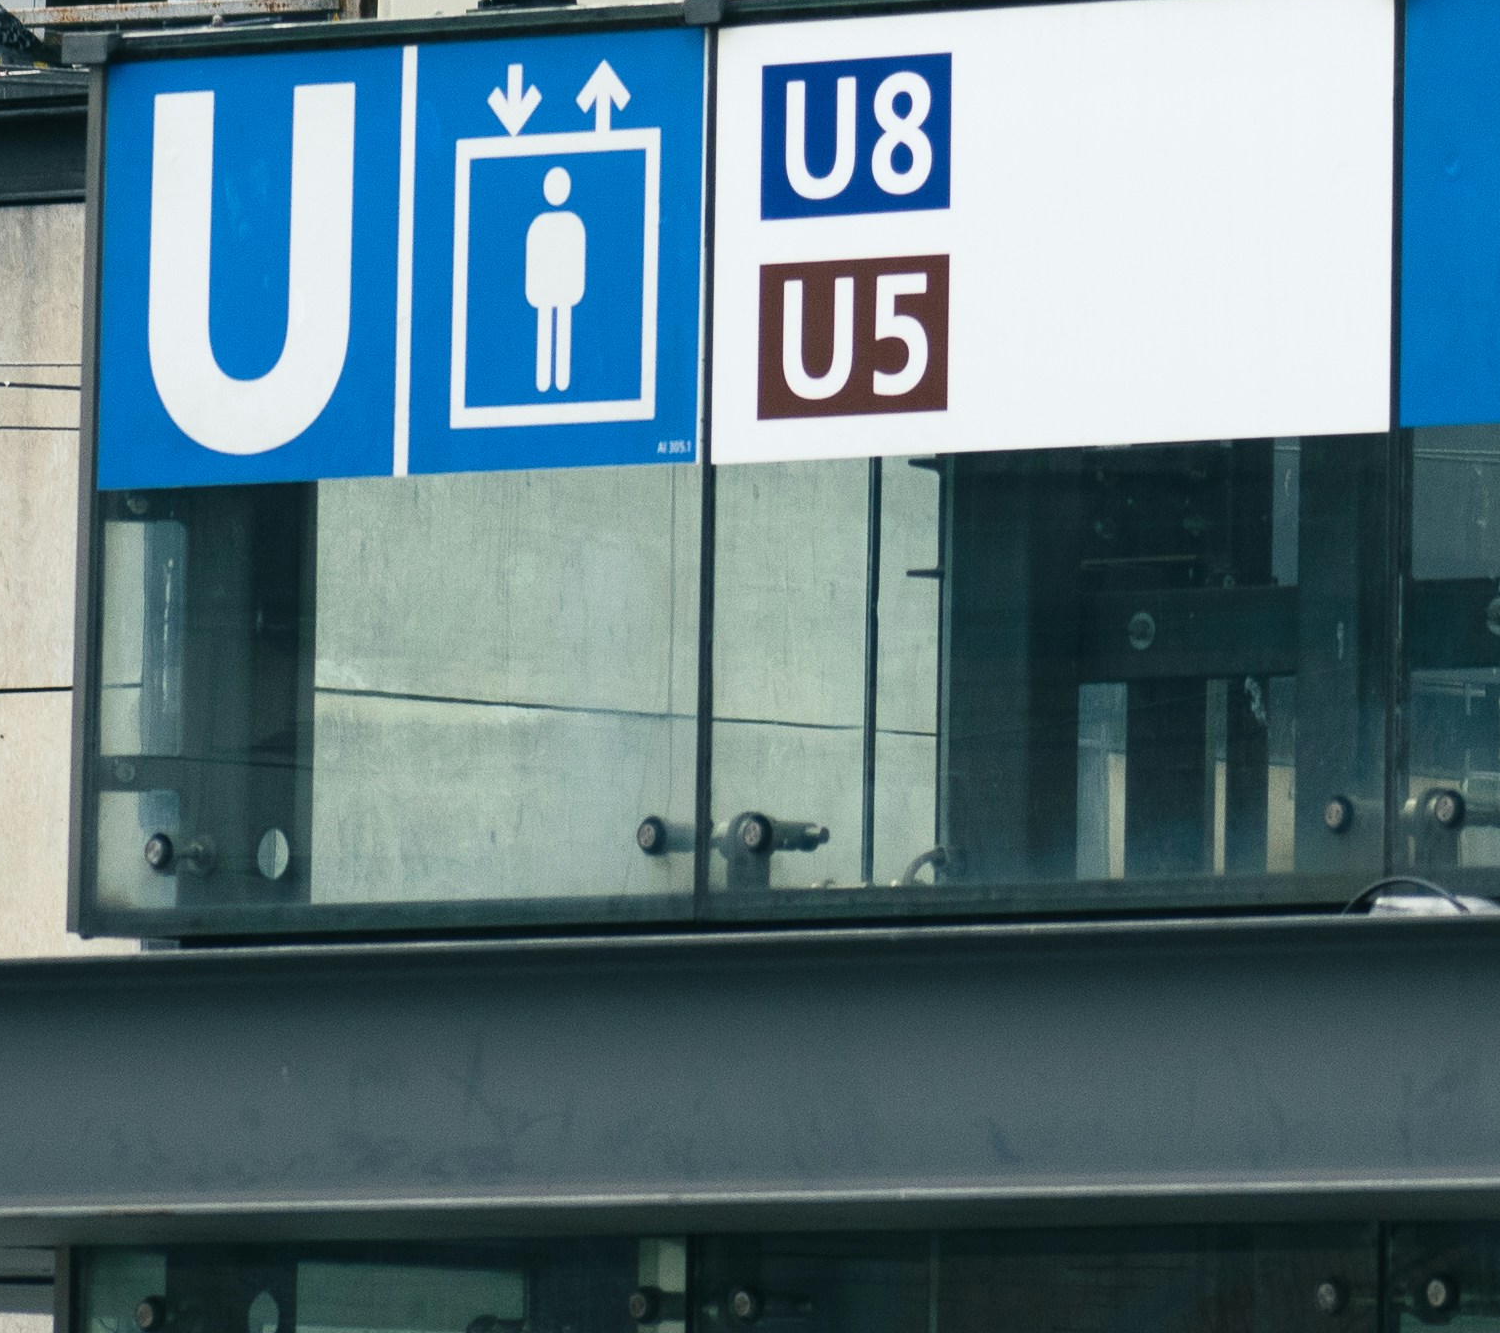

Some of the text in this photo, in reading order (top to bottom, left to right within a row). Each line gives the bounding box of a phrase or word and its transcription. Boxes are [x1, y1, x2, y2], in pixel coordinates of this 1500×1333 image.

[785, 70, 934, 201] U8
[147, 81, 356, 456] U
[782, 271, 931, 402] U5
